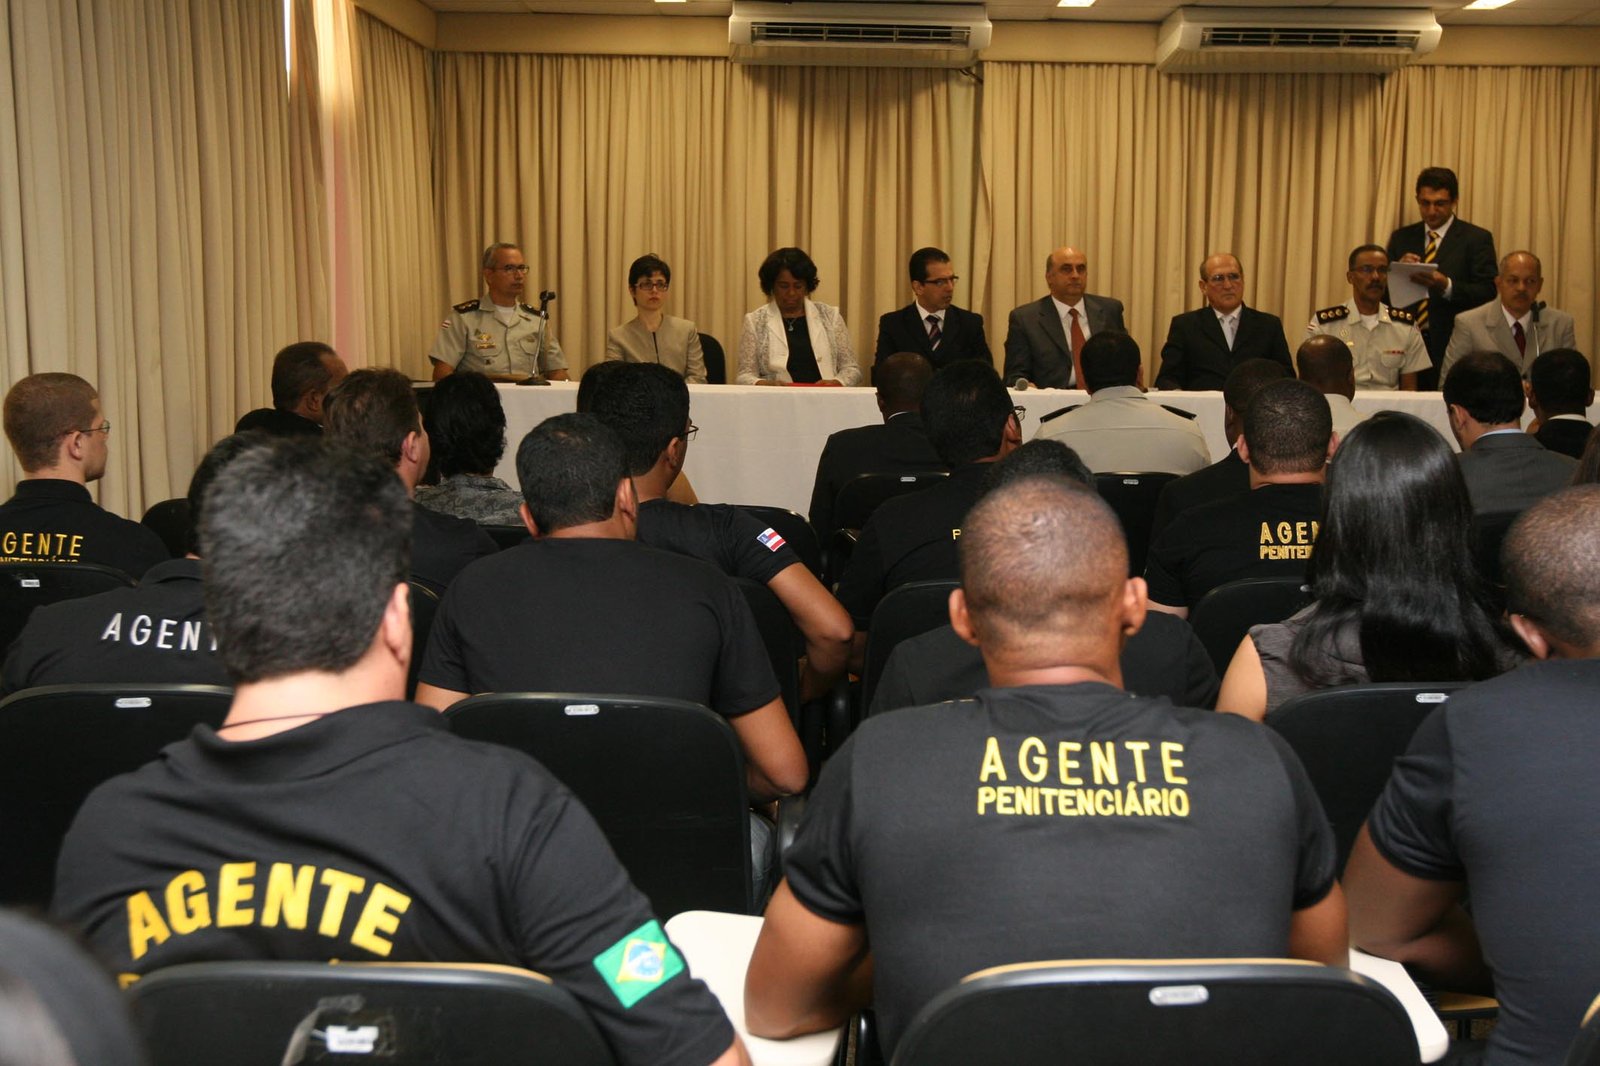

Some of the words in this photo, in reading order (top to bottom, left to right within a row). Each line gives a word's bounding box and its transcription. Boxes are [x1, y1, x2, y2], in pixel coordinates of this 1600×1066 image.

[2, 531, 84, 556] GENTE
[101, 612, 218, 651] AGEN
[979, 736, 1188, 785] AGENTE
[977, 781, 1190, 817] PENITENCIÁRIO
[127, 861, 412, 960] AGENTE
